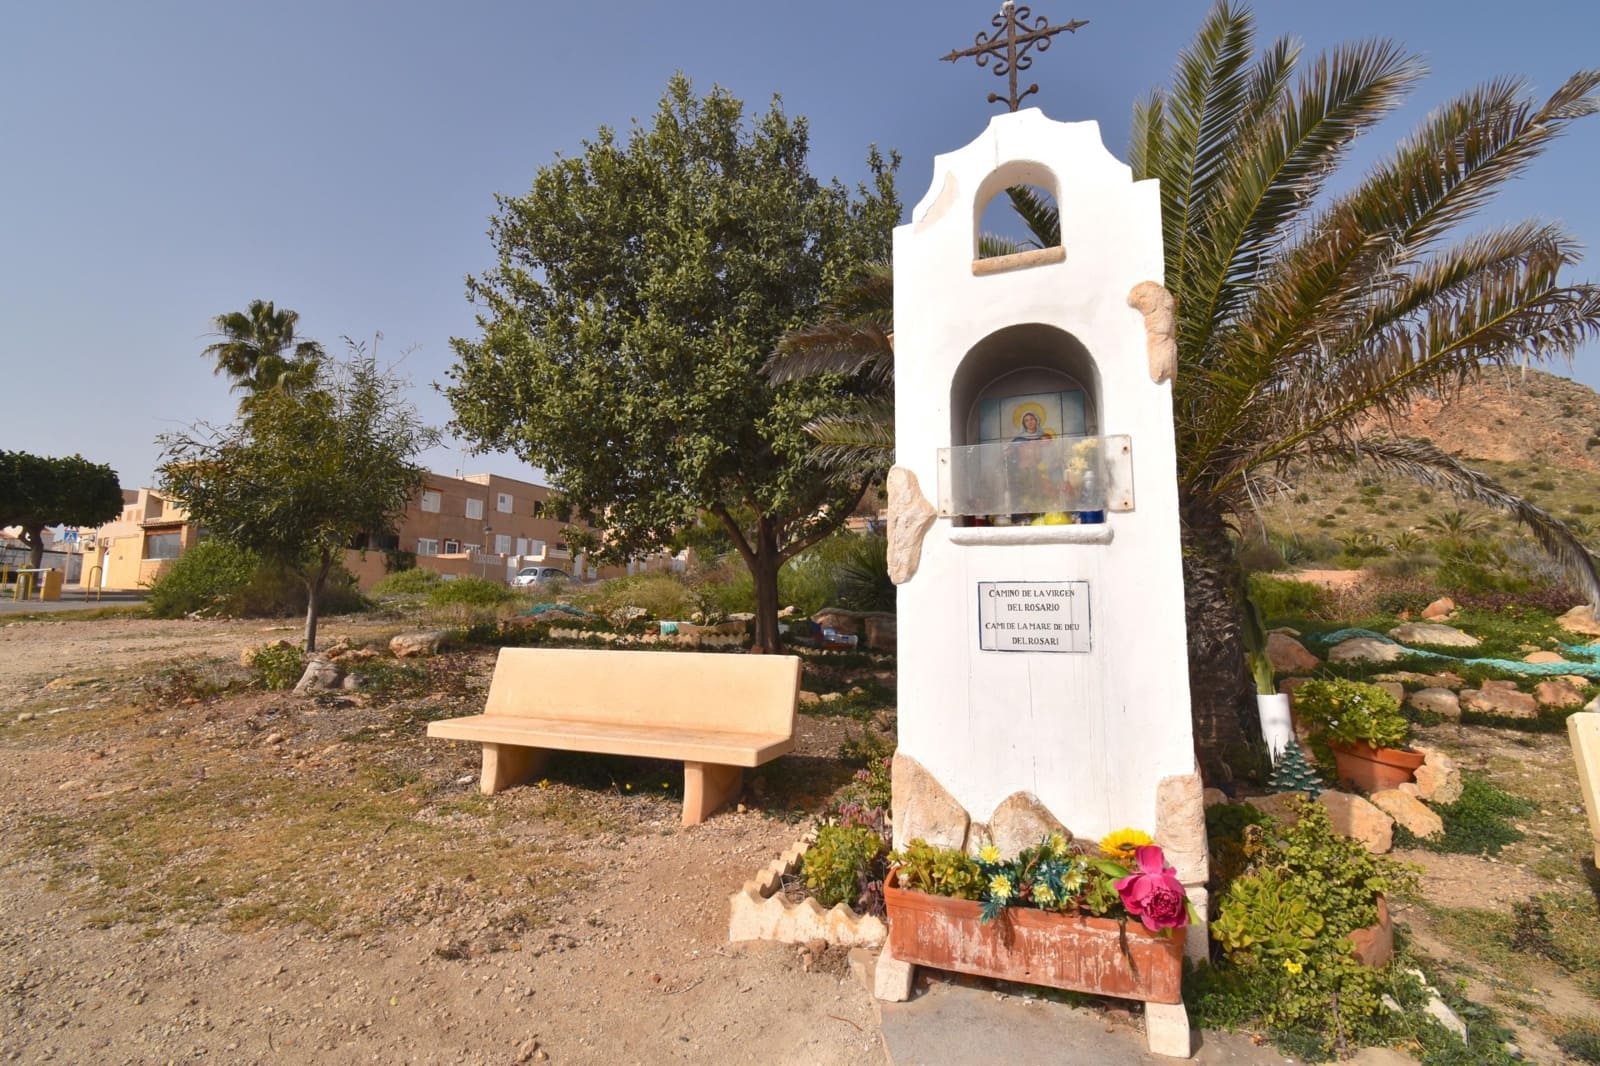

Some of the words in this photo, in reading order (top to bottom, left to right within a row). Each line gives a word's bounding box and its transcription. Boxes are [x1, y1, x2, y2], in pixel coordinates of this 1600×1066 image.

[988, 589, 1020, 598] CAMINO
[1022, 589, 1032, 598] DE
[1033, 589, 1045, 598] LA
[1045, 589, 1075, 598] VIRGEN
[1007, 603, 1023, 612] DEL
[1024, 603, 1060, 612] ROSARIO
[1006, 622, 1016, 630] DE
[1017, 622, 1027, 631] LA
[1028, 622, 1051, 631] MARE
[1053, 623, 1063, 631] DE
[1064, 623, 1080, 631] DEU
[1012, 637, 1026, 645] DEL
[1028, 637, 1059, 646] ROSARI
